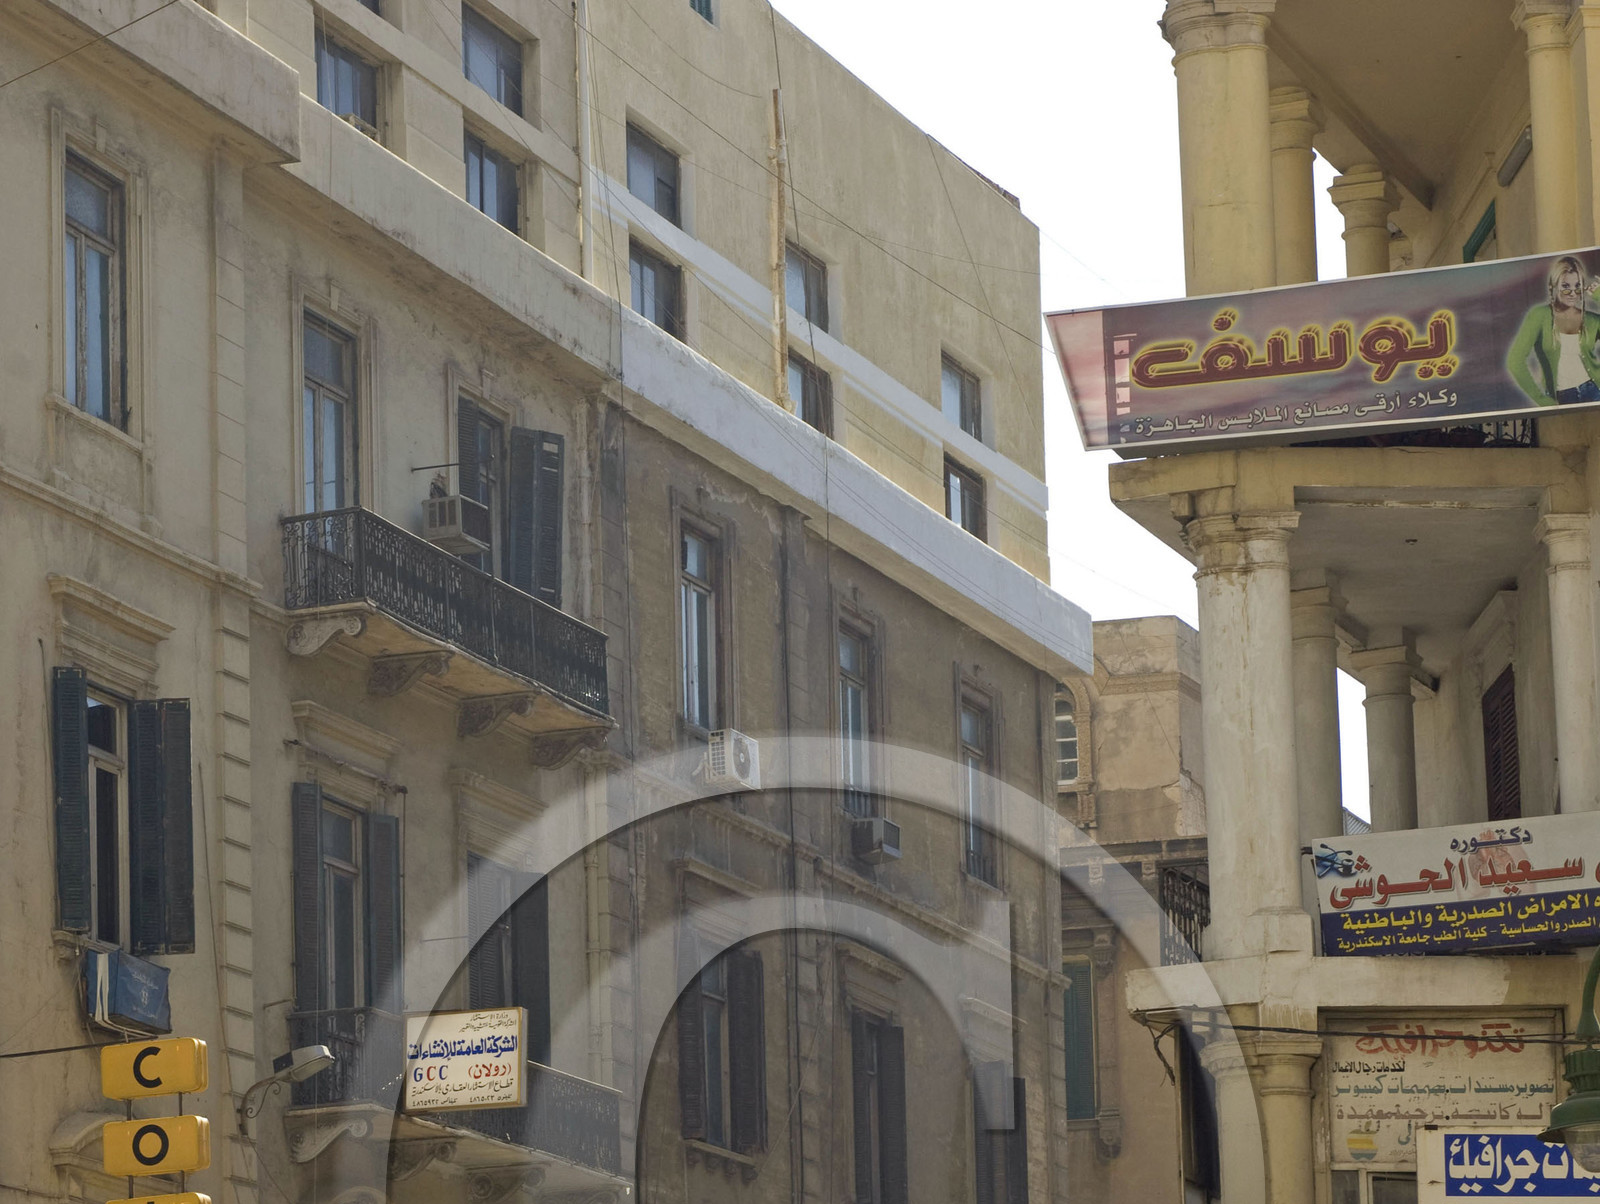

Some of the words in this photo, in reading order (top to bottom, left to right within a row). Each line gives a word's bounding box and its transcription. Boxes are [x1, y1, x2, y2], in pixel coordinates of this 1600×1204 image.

[1131, 308, 1460, 389] يوسف
[1294, 398, 1350, 426] مصانع
[1408, 389, 1458, 413] وكلاء
[1134, 413, 1213, 437] الجاهزة
[1219, 406, 1289, 431] الملابس
[1479, 856, 1585, 897] سعيد
[1341, 909, 1433, 935] والباطنية
[1438, 901, 1512, 928] الصدرية
[1399, 932, 1429, 945] جامعة
[1464, 926, 1487, 940] كلية
[458, 1039, 487, 1056] العامة
[487, 1035, 518, 1058] الشركة
[1449, 1135, 1540, 1194] جرافيك
